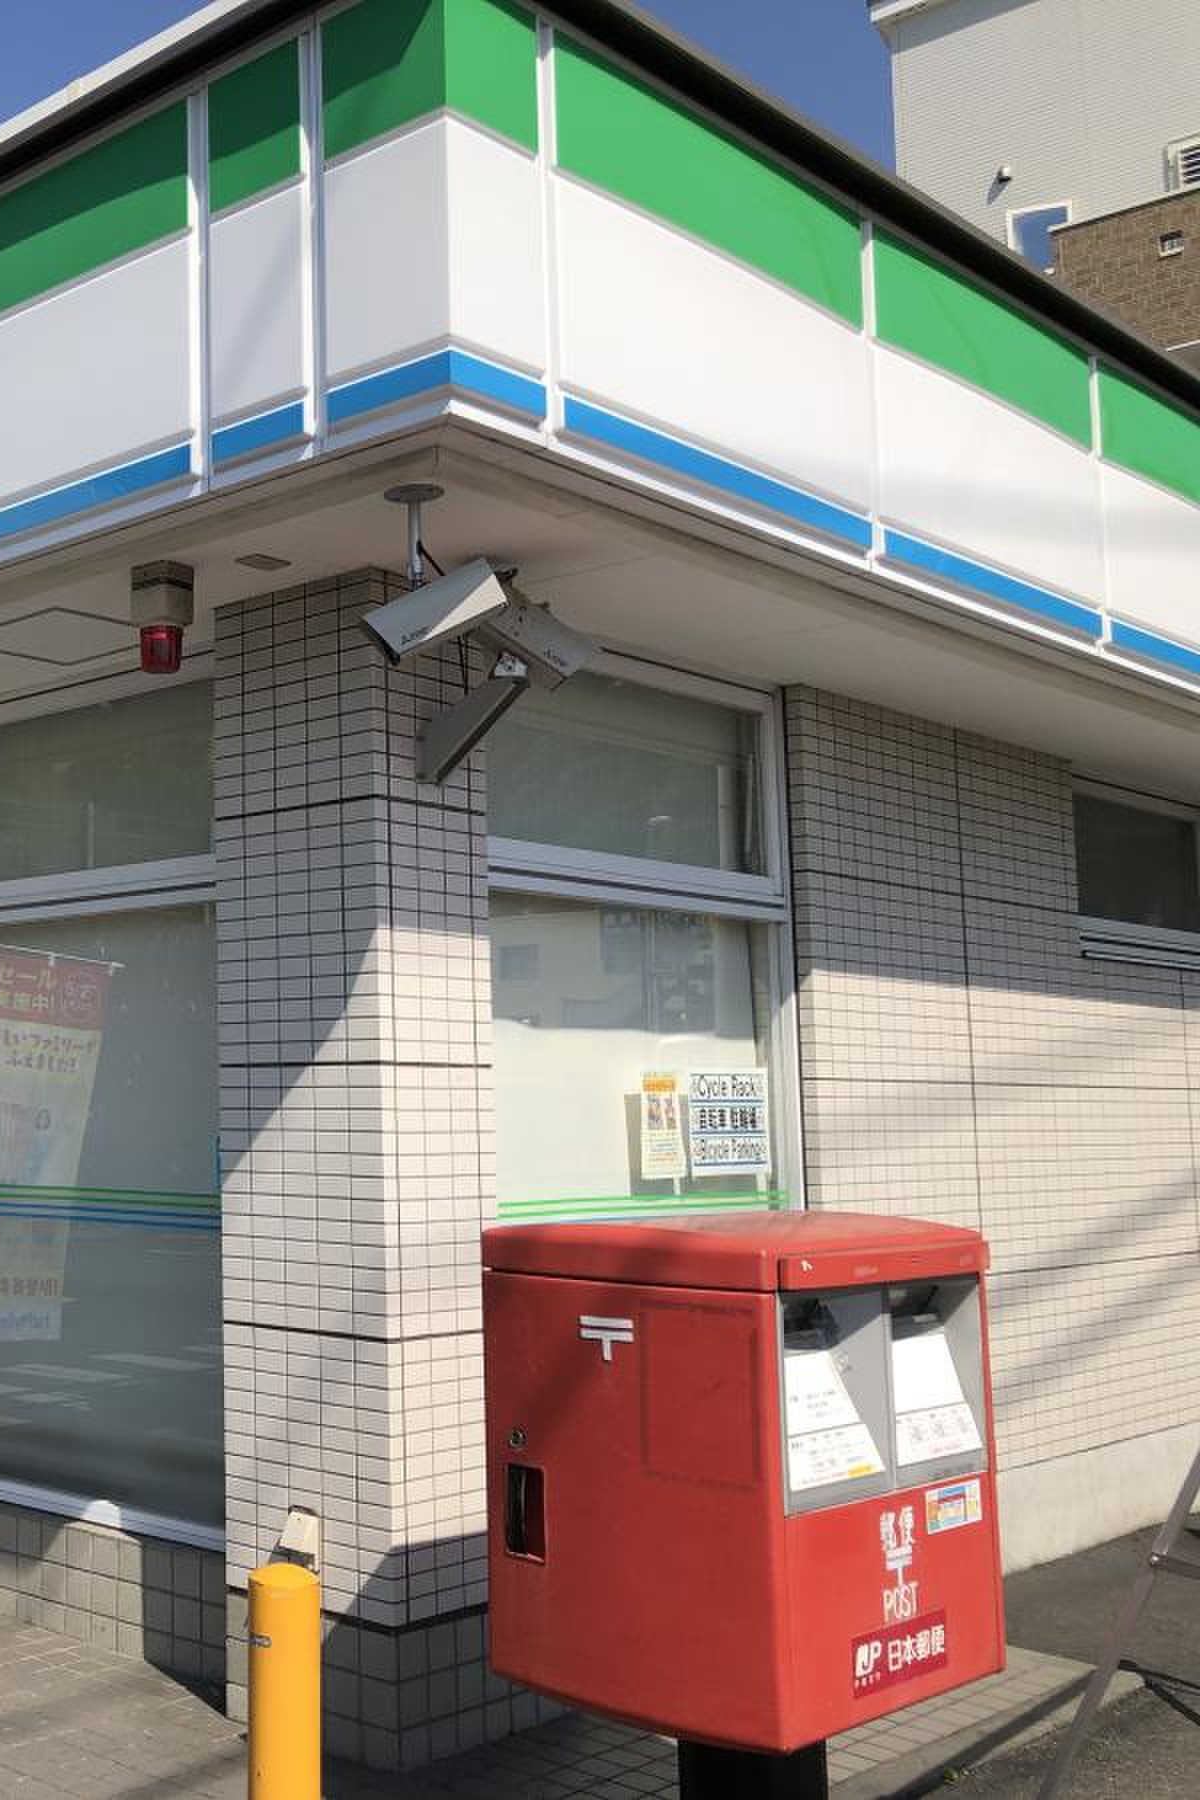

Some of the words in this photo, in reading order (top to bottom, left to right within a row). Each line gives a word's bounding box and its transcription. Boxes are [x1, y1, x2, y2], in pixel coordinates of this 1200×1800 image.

[698, 1074, 727, 1098] Cycle
[731, 1074, 757, 1097] Rack
[699, 1108, 726, 1129] 自転車
[880, 1506, 915, 1549] 郵便
[882, 1581, 919, 1622] POST
[888, 1624, 945, 1672] 日本郵便
